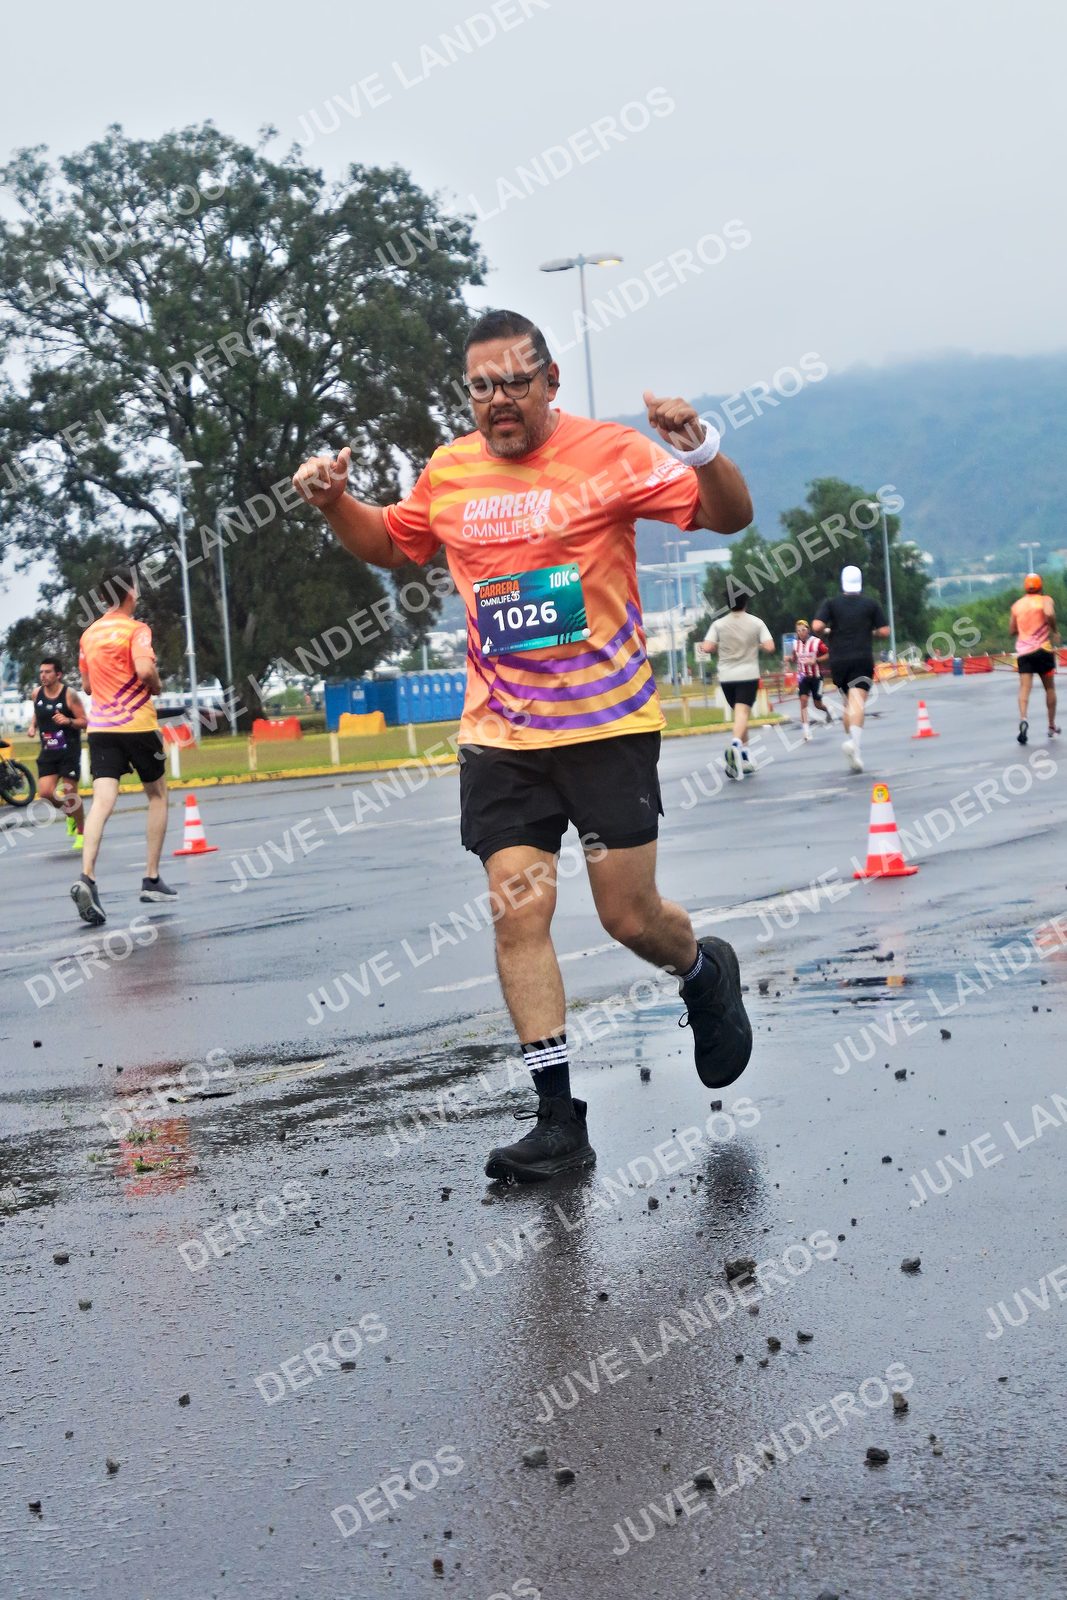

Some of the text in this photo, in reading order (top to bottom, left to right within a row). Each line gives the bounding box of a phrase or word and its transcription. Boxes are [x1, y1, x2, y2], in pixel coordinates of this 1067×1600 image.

[464, 488, 552, 521] CARRERA
[479, 580, 520, 599] CARRERA
[549, 570, 569, 588] 10K
[493, 600, 558, 632] 1026
